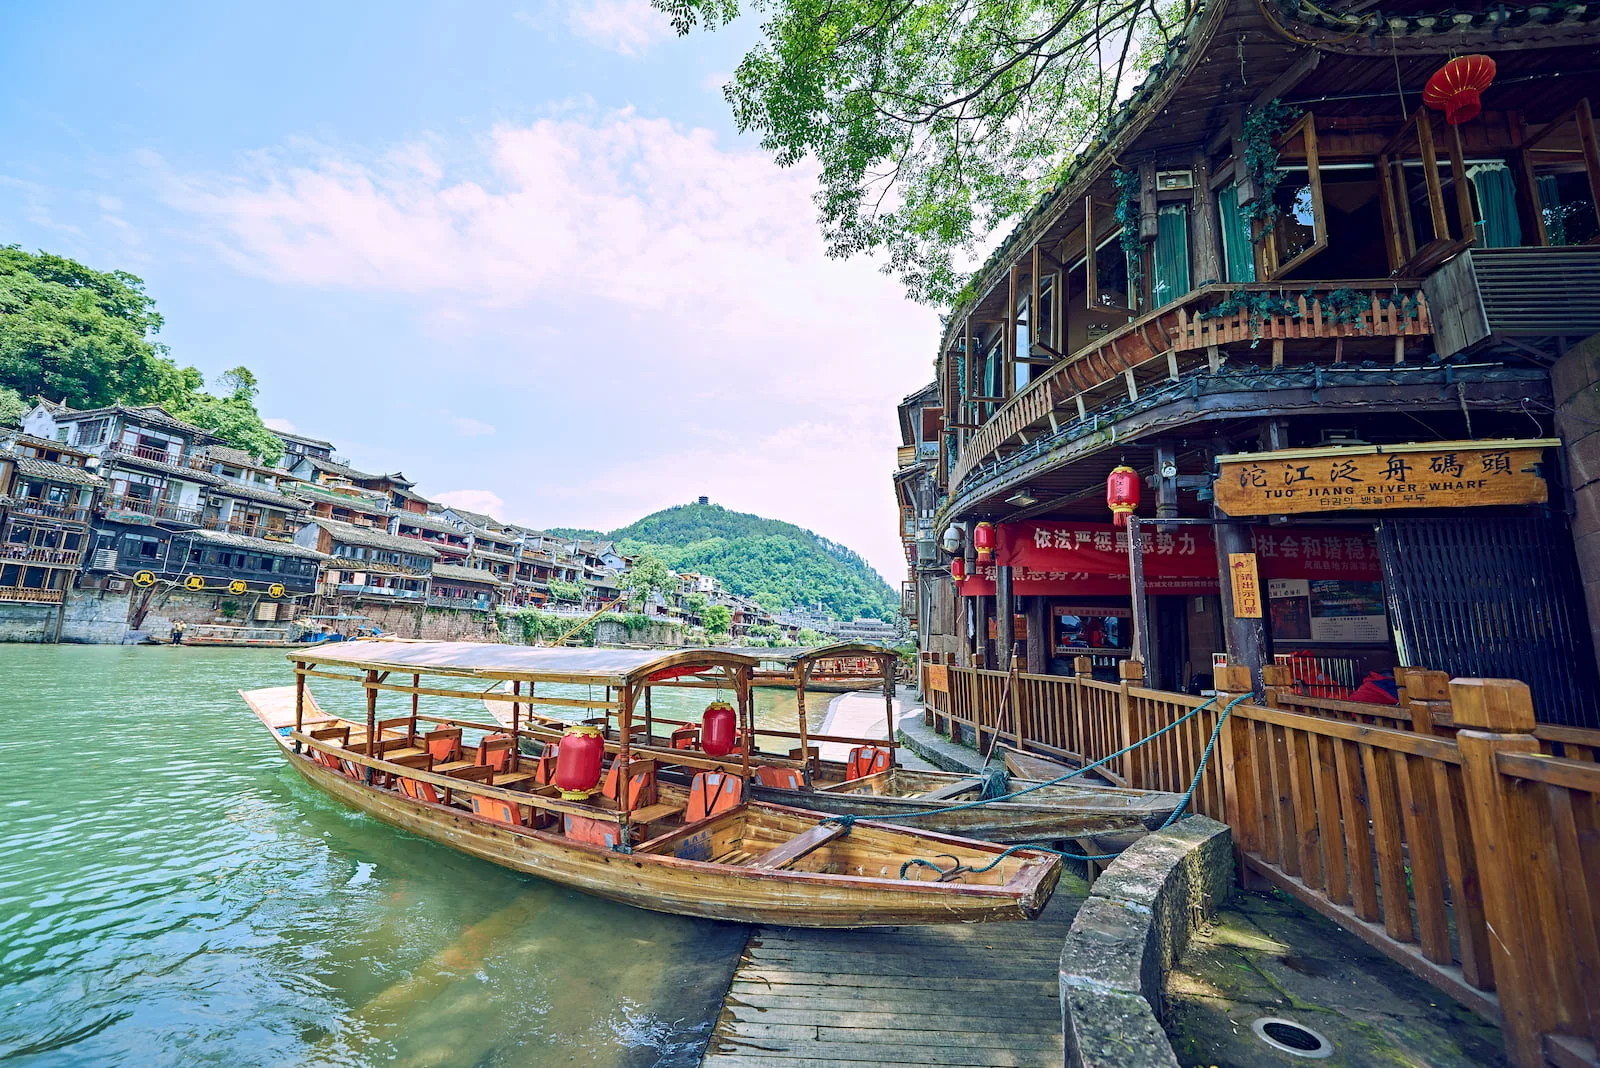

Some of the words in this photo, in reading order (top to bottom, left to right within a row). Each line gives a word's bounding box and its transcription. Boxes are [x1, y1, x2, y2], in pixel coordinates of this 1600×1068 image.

[1240, 452, 1513, 488] 沱江泛舟碼頭
[1264, 489, 1295, 499] TUO
[1307, 486, 1355, 497] JIANG
[1367, 484, 1418, 494] RIVER
[1429, 479, 1488, 492] WHARF
[1034, 527, 1196, 556] 依法严惩黑恶势力
[1242, 573, 1257, 615] 请出示门票
